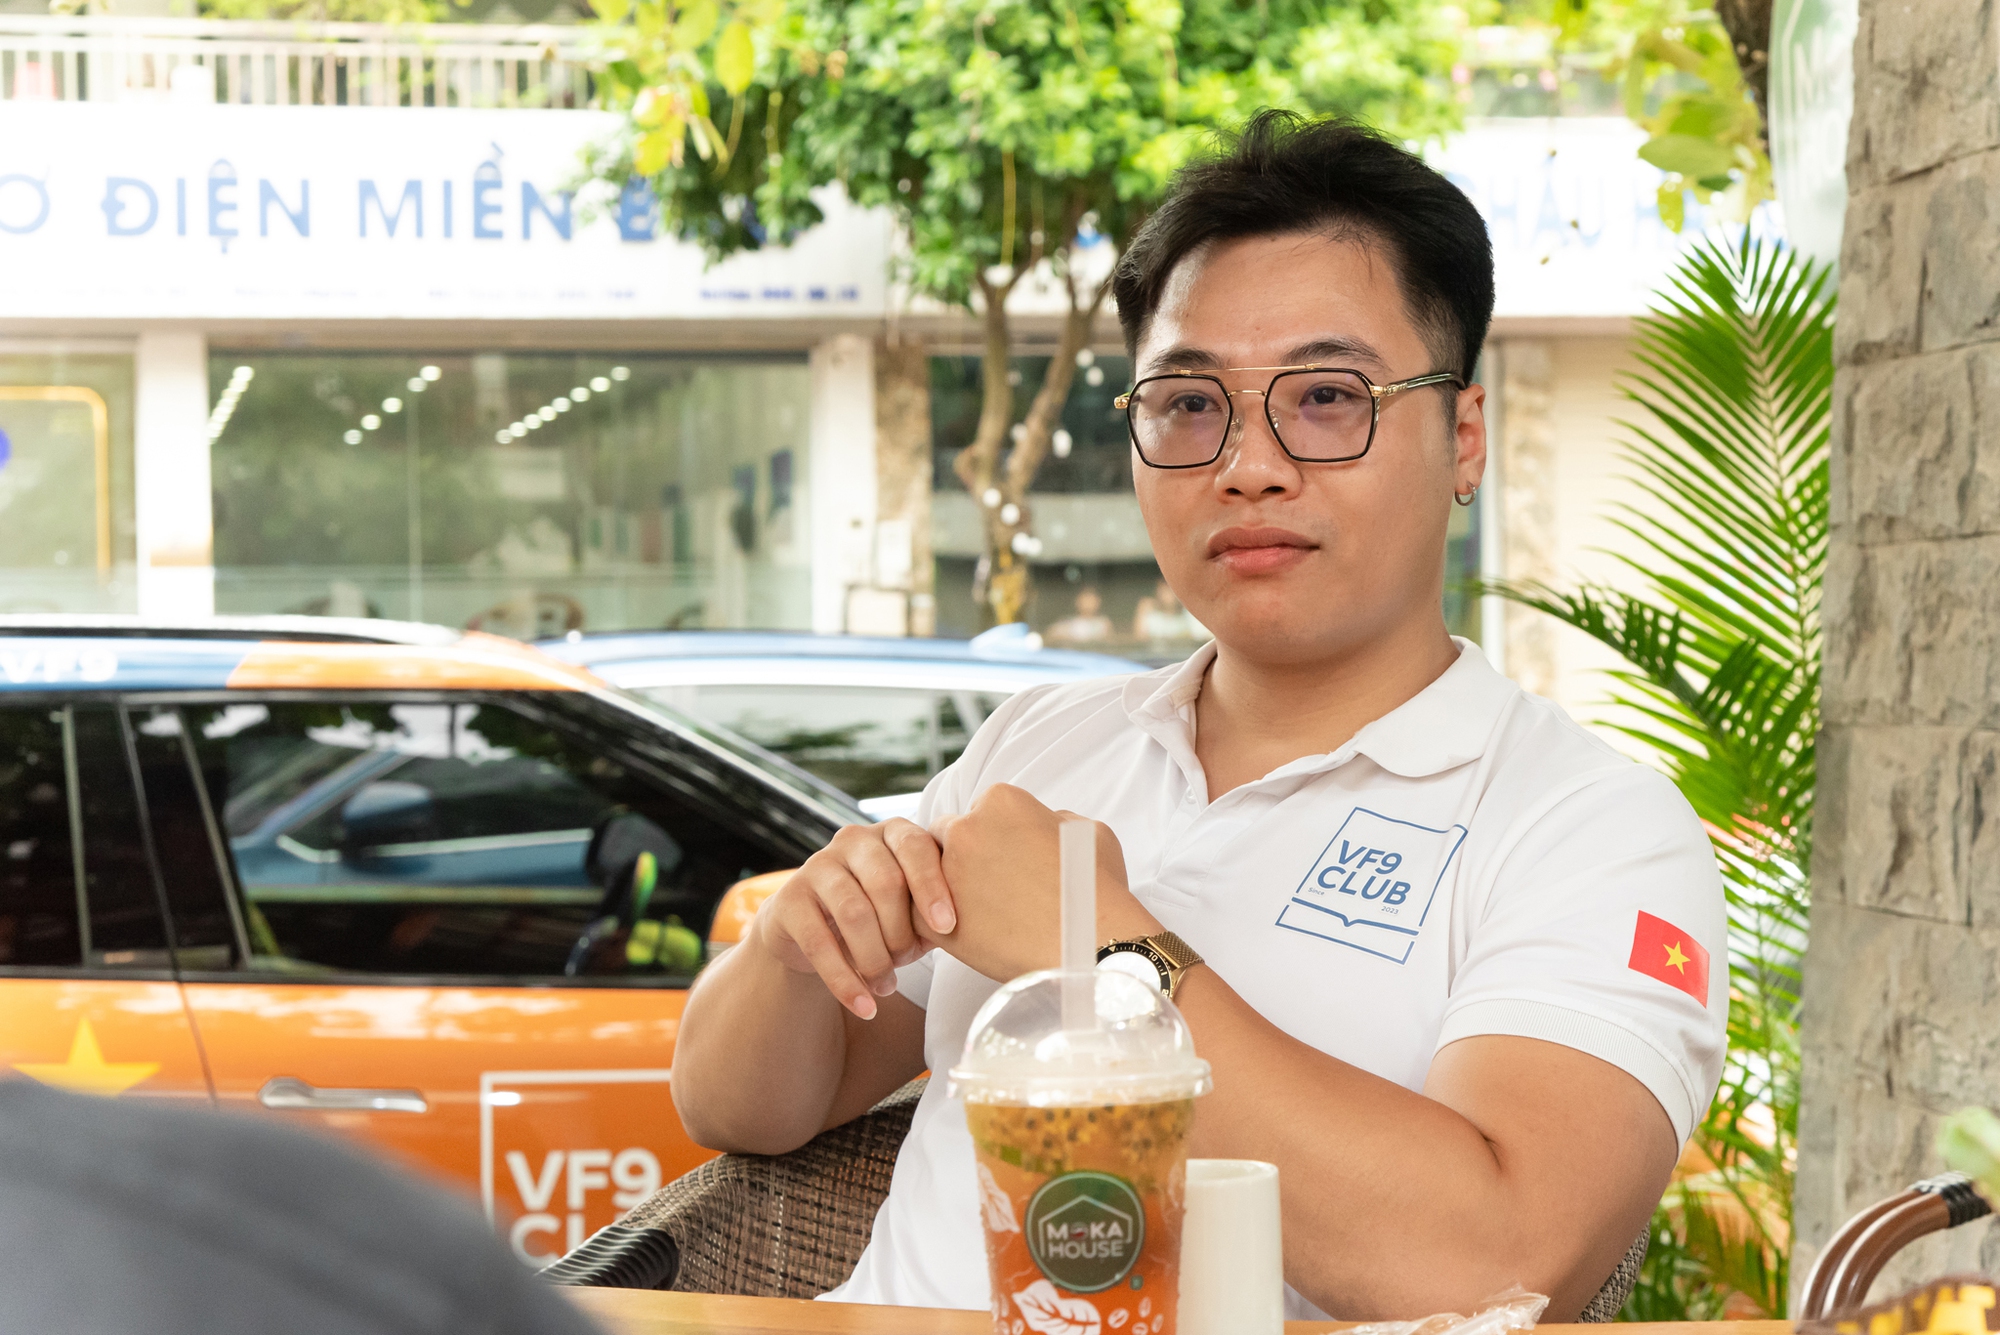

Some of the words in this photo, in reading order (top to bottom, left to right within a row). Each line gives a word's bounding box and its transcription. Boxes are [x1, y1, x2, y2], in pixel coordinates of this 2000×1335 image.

[101, 157, 310, 254] ĐIỆN
[358, 140, 572, 241] MIỀN
[0, 650, 118, 683] VF9
[1338, 839, 1403, 875] VF9
[1308, 887, 1325, 895] Since
[1381, 906, 1399, 915] 2023
[1317, 865, 1412, 905] CLUB
[1149, 951, 1158, 961] 10
[505, 1147, 662, 1211] VF9
[1047, 1240, 1124, 1259] HOUSE
